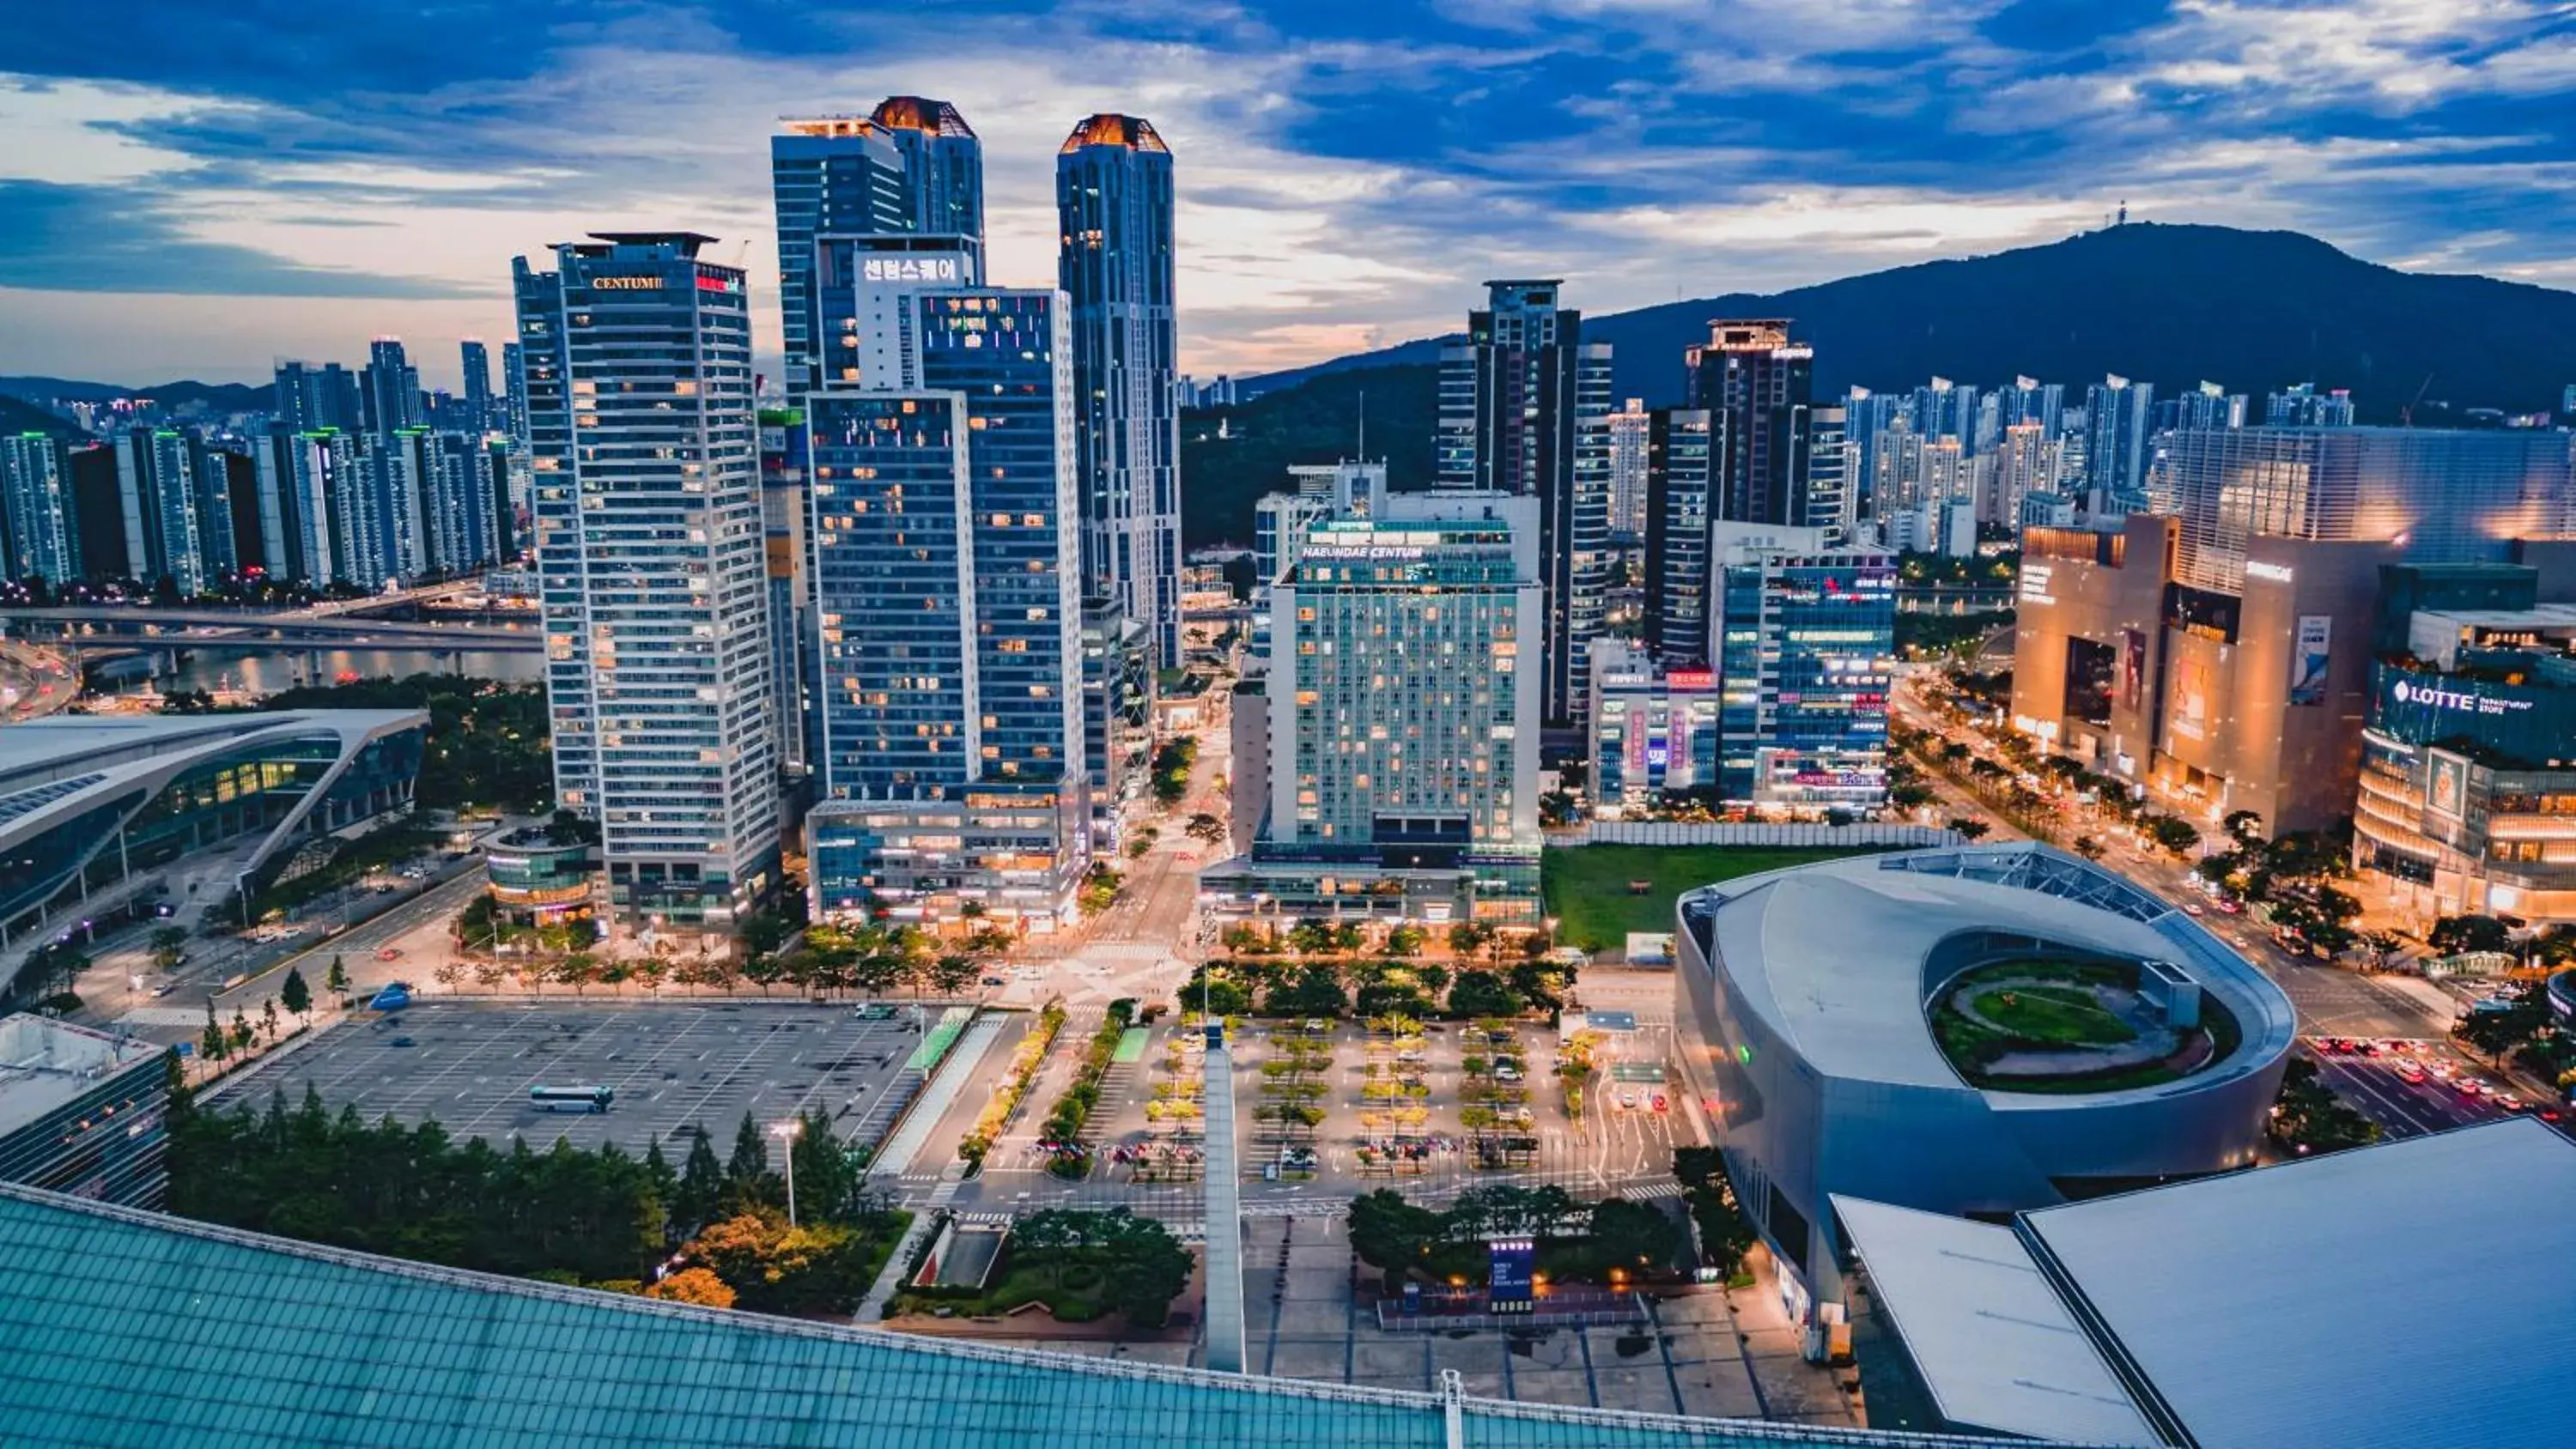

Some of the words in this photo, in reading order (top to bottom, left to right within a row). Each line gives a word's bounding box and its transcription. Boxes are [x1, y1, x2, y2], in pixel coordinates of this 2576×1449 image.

[1303, 546, 1368, 558] HAEUNDAE
[1370, 547, 1423, 558] CENTUM
[2410, 686, 2475, 712] LOTTE
